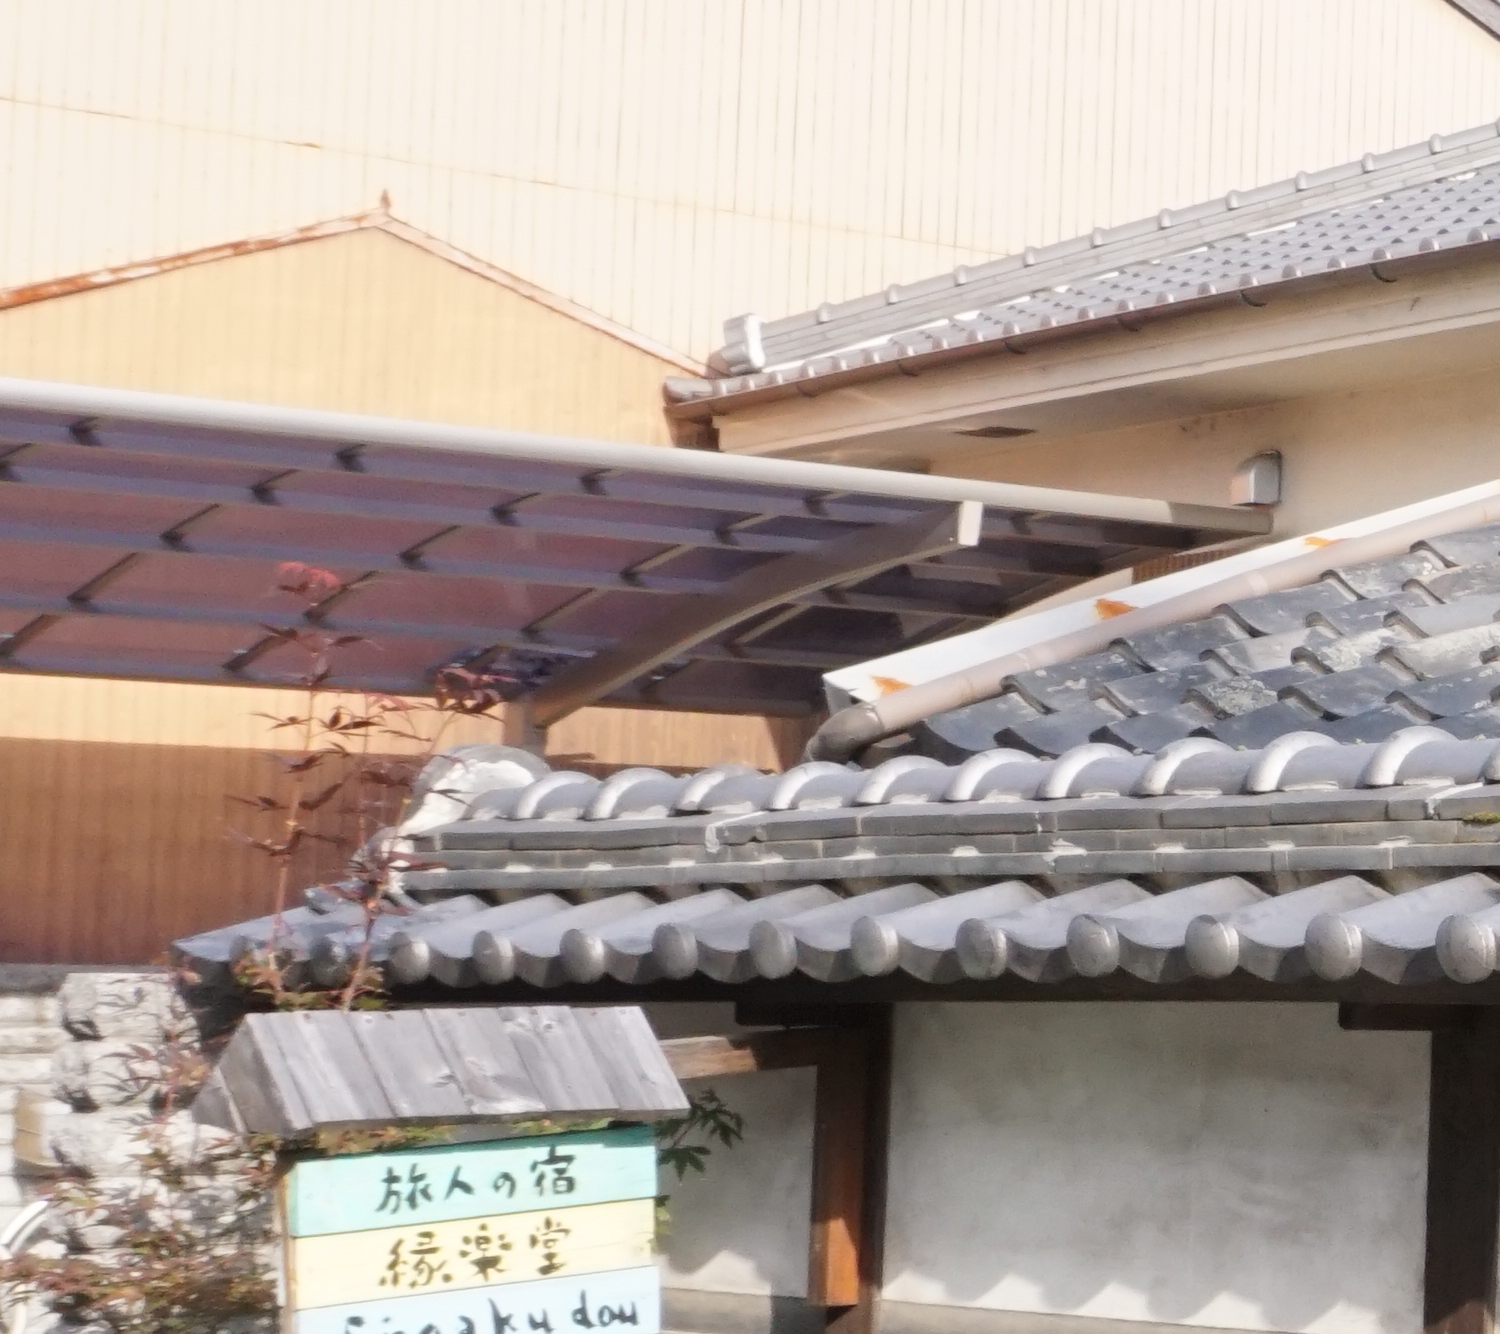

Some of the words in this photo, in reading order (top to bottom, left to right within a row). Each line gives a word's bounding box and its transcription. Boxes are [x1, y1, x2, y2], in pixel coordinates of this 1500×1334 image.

[375, 1146, 577, 1215] 旅人の宿
[377, 1217, 571, 1289] 縁楽堂
